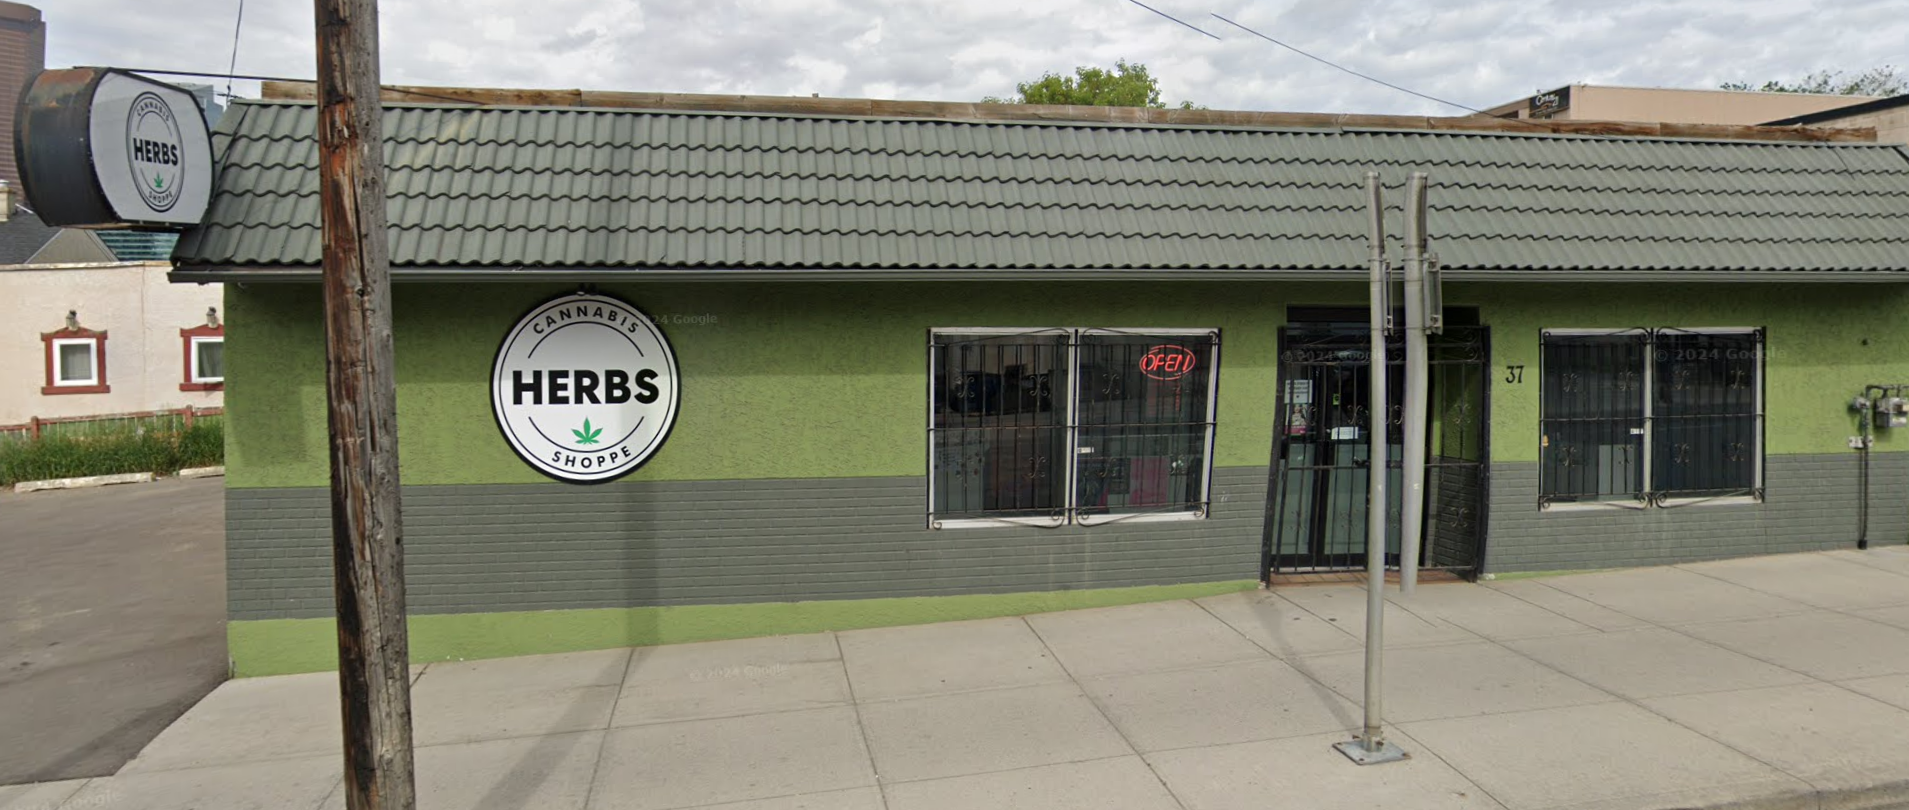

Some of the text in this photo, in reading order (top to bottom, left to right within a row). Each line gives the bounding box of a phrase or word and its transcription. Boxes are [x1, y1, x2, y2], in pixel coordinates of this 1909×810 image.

[136, 101, 170, 122] CANNABIS
[133, 137, 179, 166] HERBS
[148, 190, 173, 204] SHOPPE
[532, 305, 639, 335] CANNABIS
[1142, 353, 1191, 371] OPEN
[1505, 365, 1525, 384] 37
[512, 368, 659, 405] HERBS
[551, 445, 632, 469] SHOPPE
